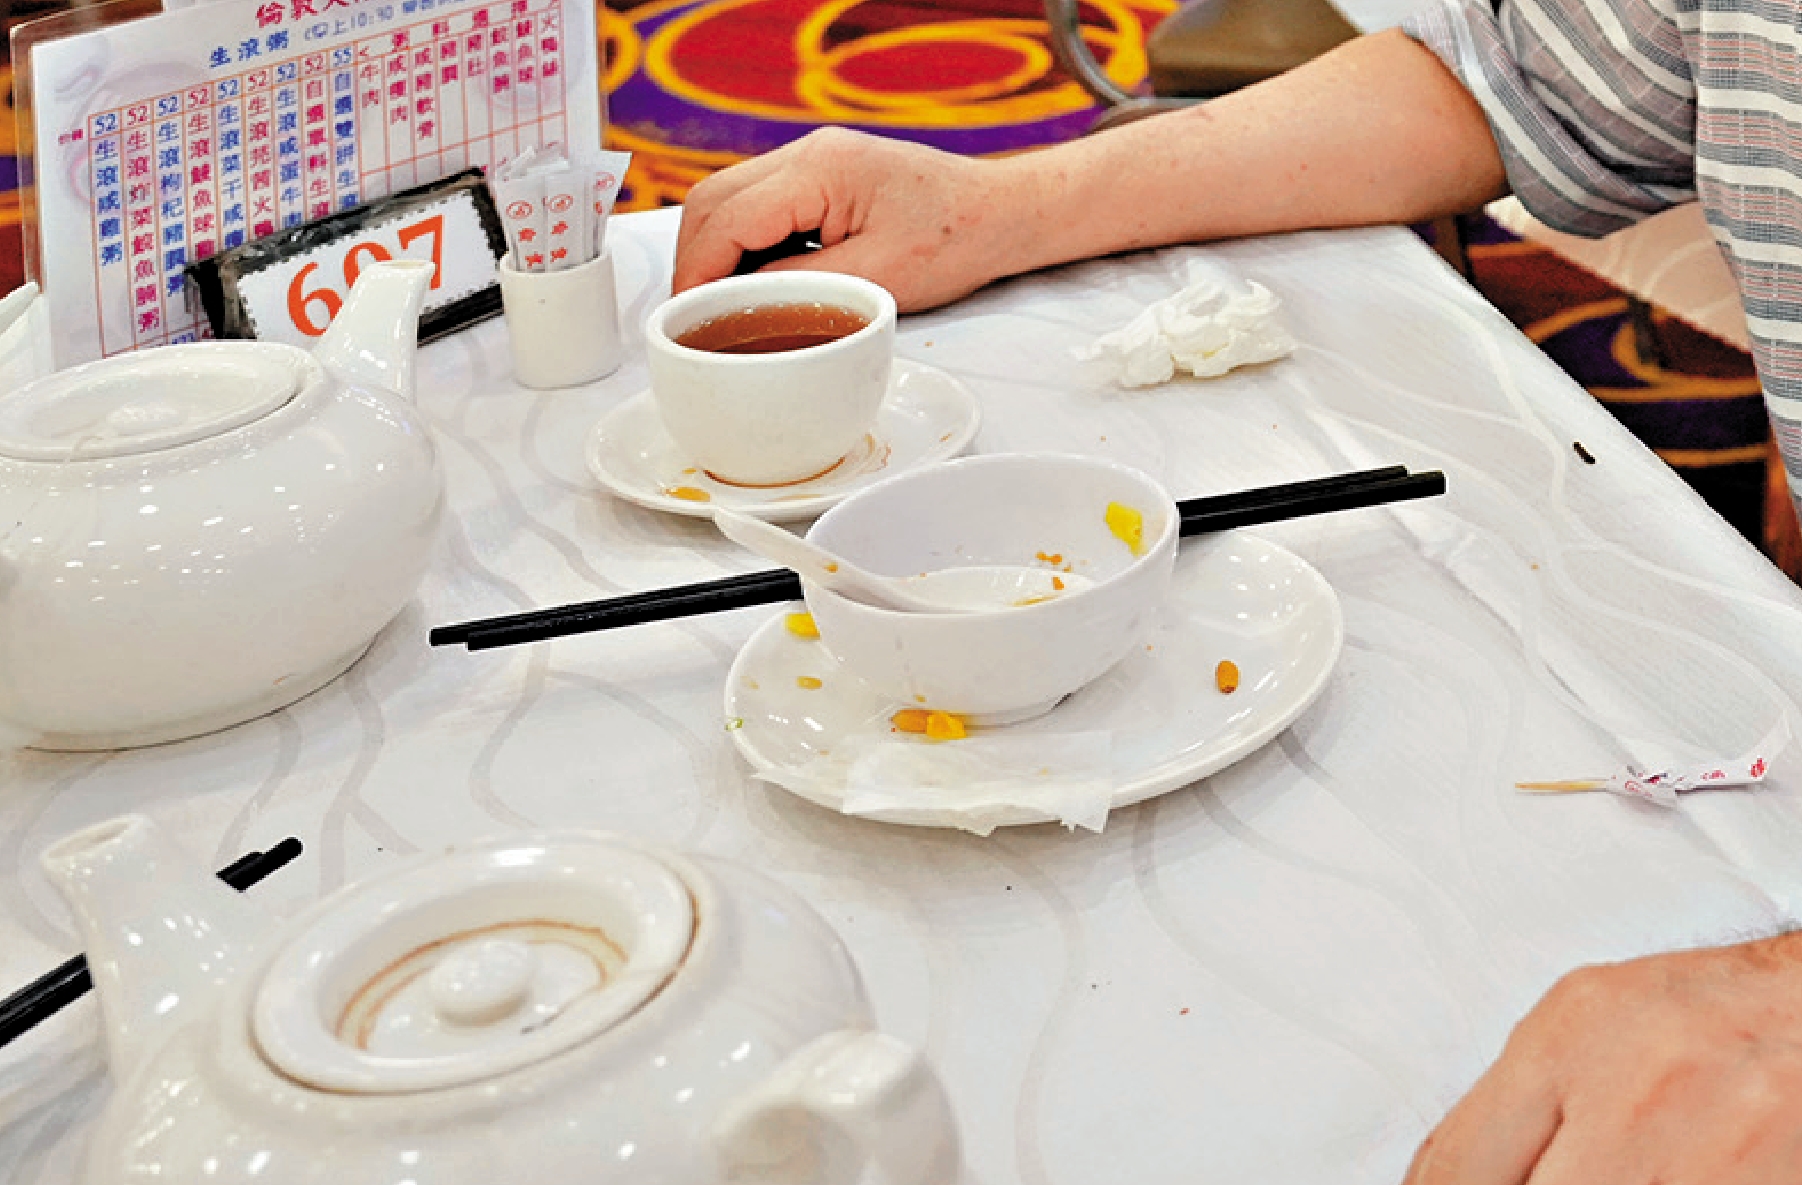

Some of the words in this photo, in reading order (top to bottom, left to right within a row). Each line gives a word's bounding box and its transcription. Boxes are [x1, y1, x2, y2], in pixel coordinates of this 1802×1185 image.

[209, 30, 290, 67] 生滾粥
[95, 113, 116, 136] 52
[127, 104, 148, 125] 52
[158, 95, 179, 116] 52
[188, 88, 210, 109] 52
[218, 79, 239, 100] 52
[248, 69, 268, 91] 52
[277, 62, 297, 84] 52
[304, 54, 324, 75] 52
[333, 46, 352, 68] 55
